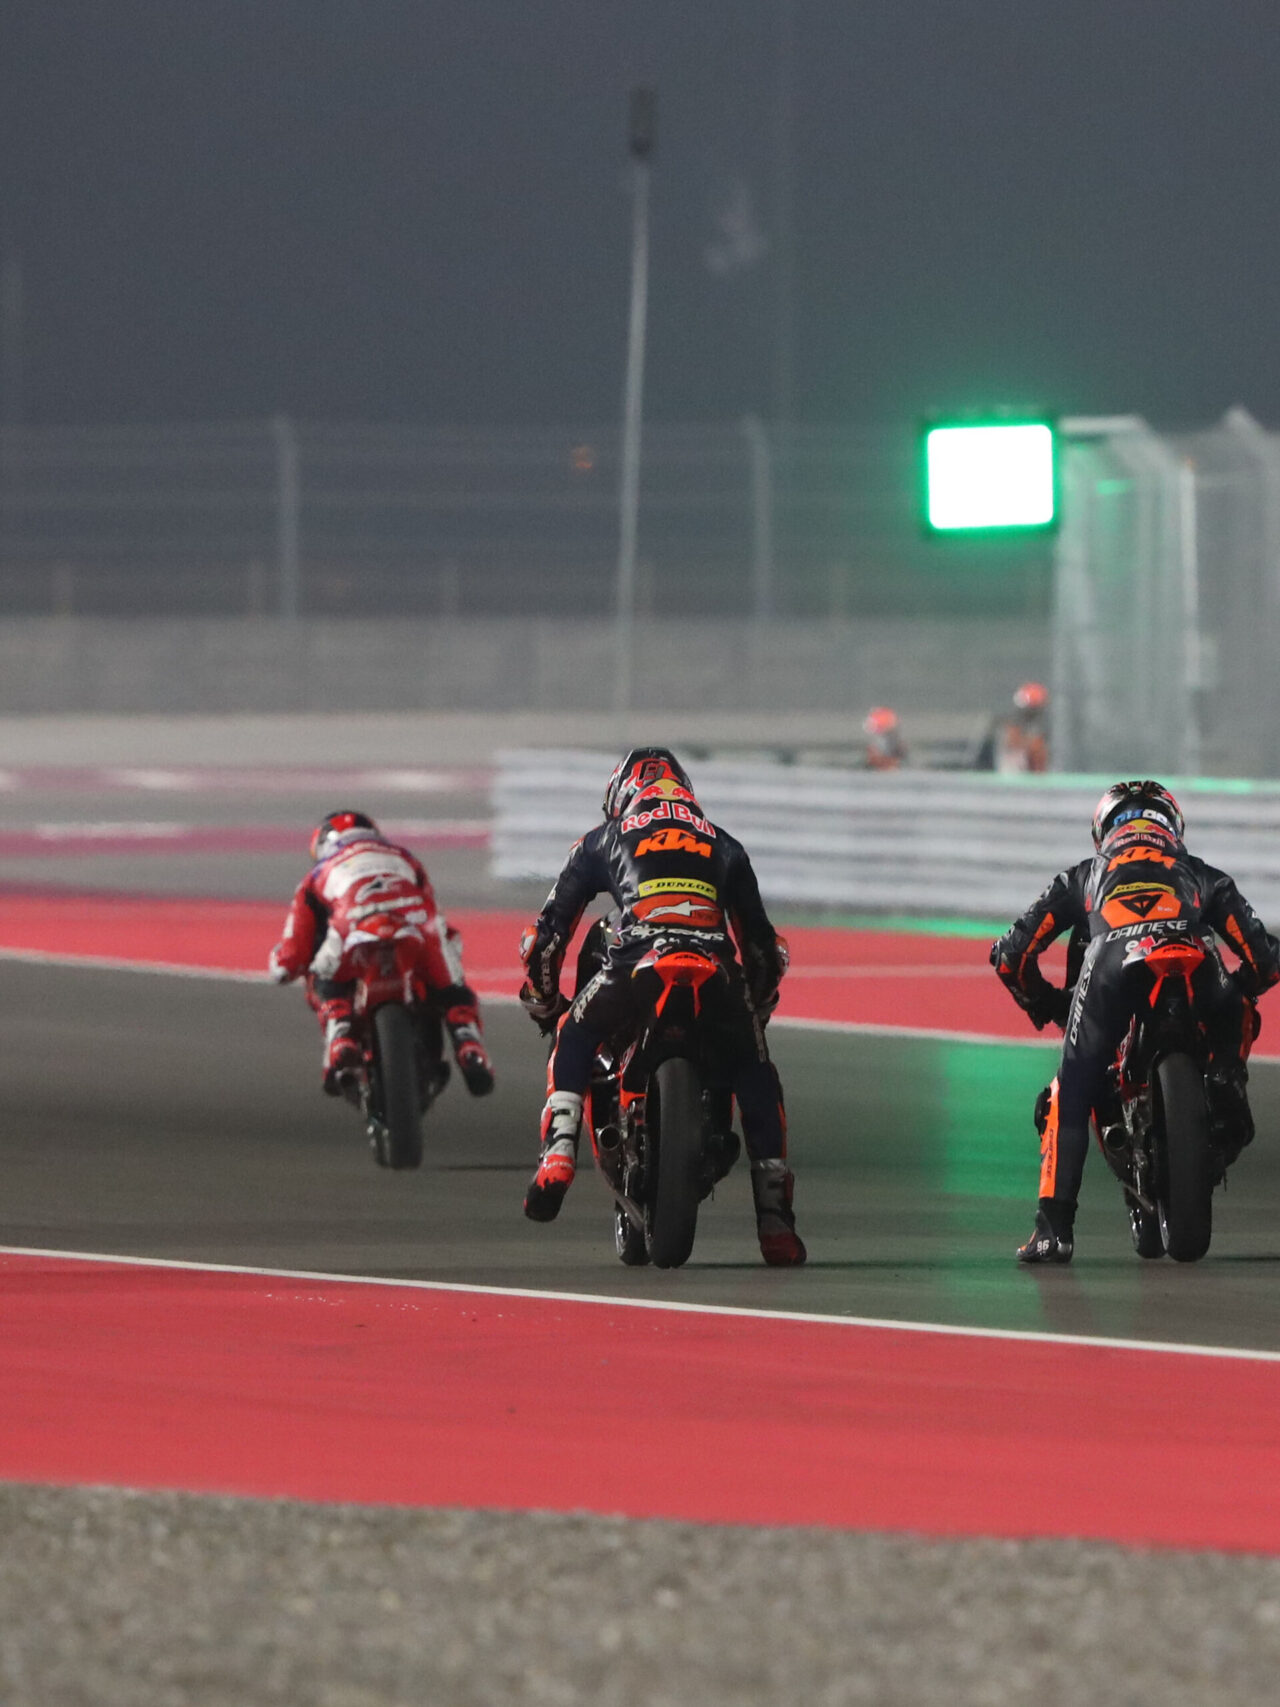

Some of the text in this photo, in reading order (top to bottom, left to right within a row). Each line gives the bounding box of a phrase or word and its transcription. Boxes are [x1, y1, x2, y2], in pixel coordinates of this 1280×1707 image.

[621, 801, 716, 838] Red Bull
[634, 828, 712, 857] KTM
[1107, 846, 1176, 872] KTM
[656, 881, 714, 893] DUNLOP
[1106, 920, 1187, 942] DAINESE
[1037, 1239, 1050, 1252] 96
